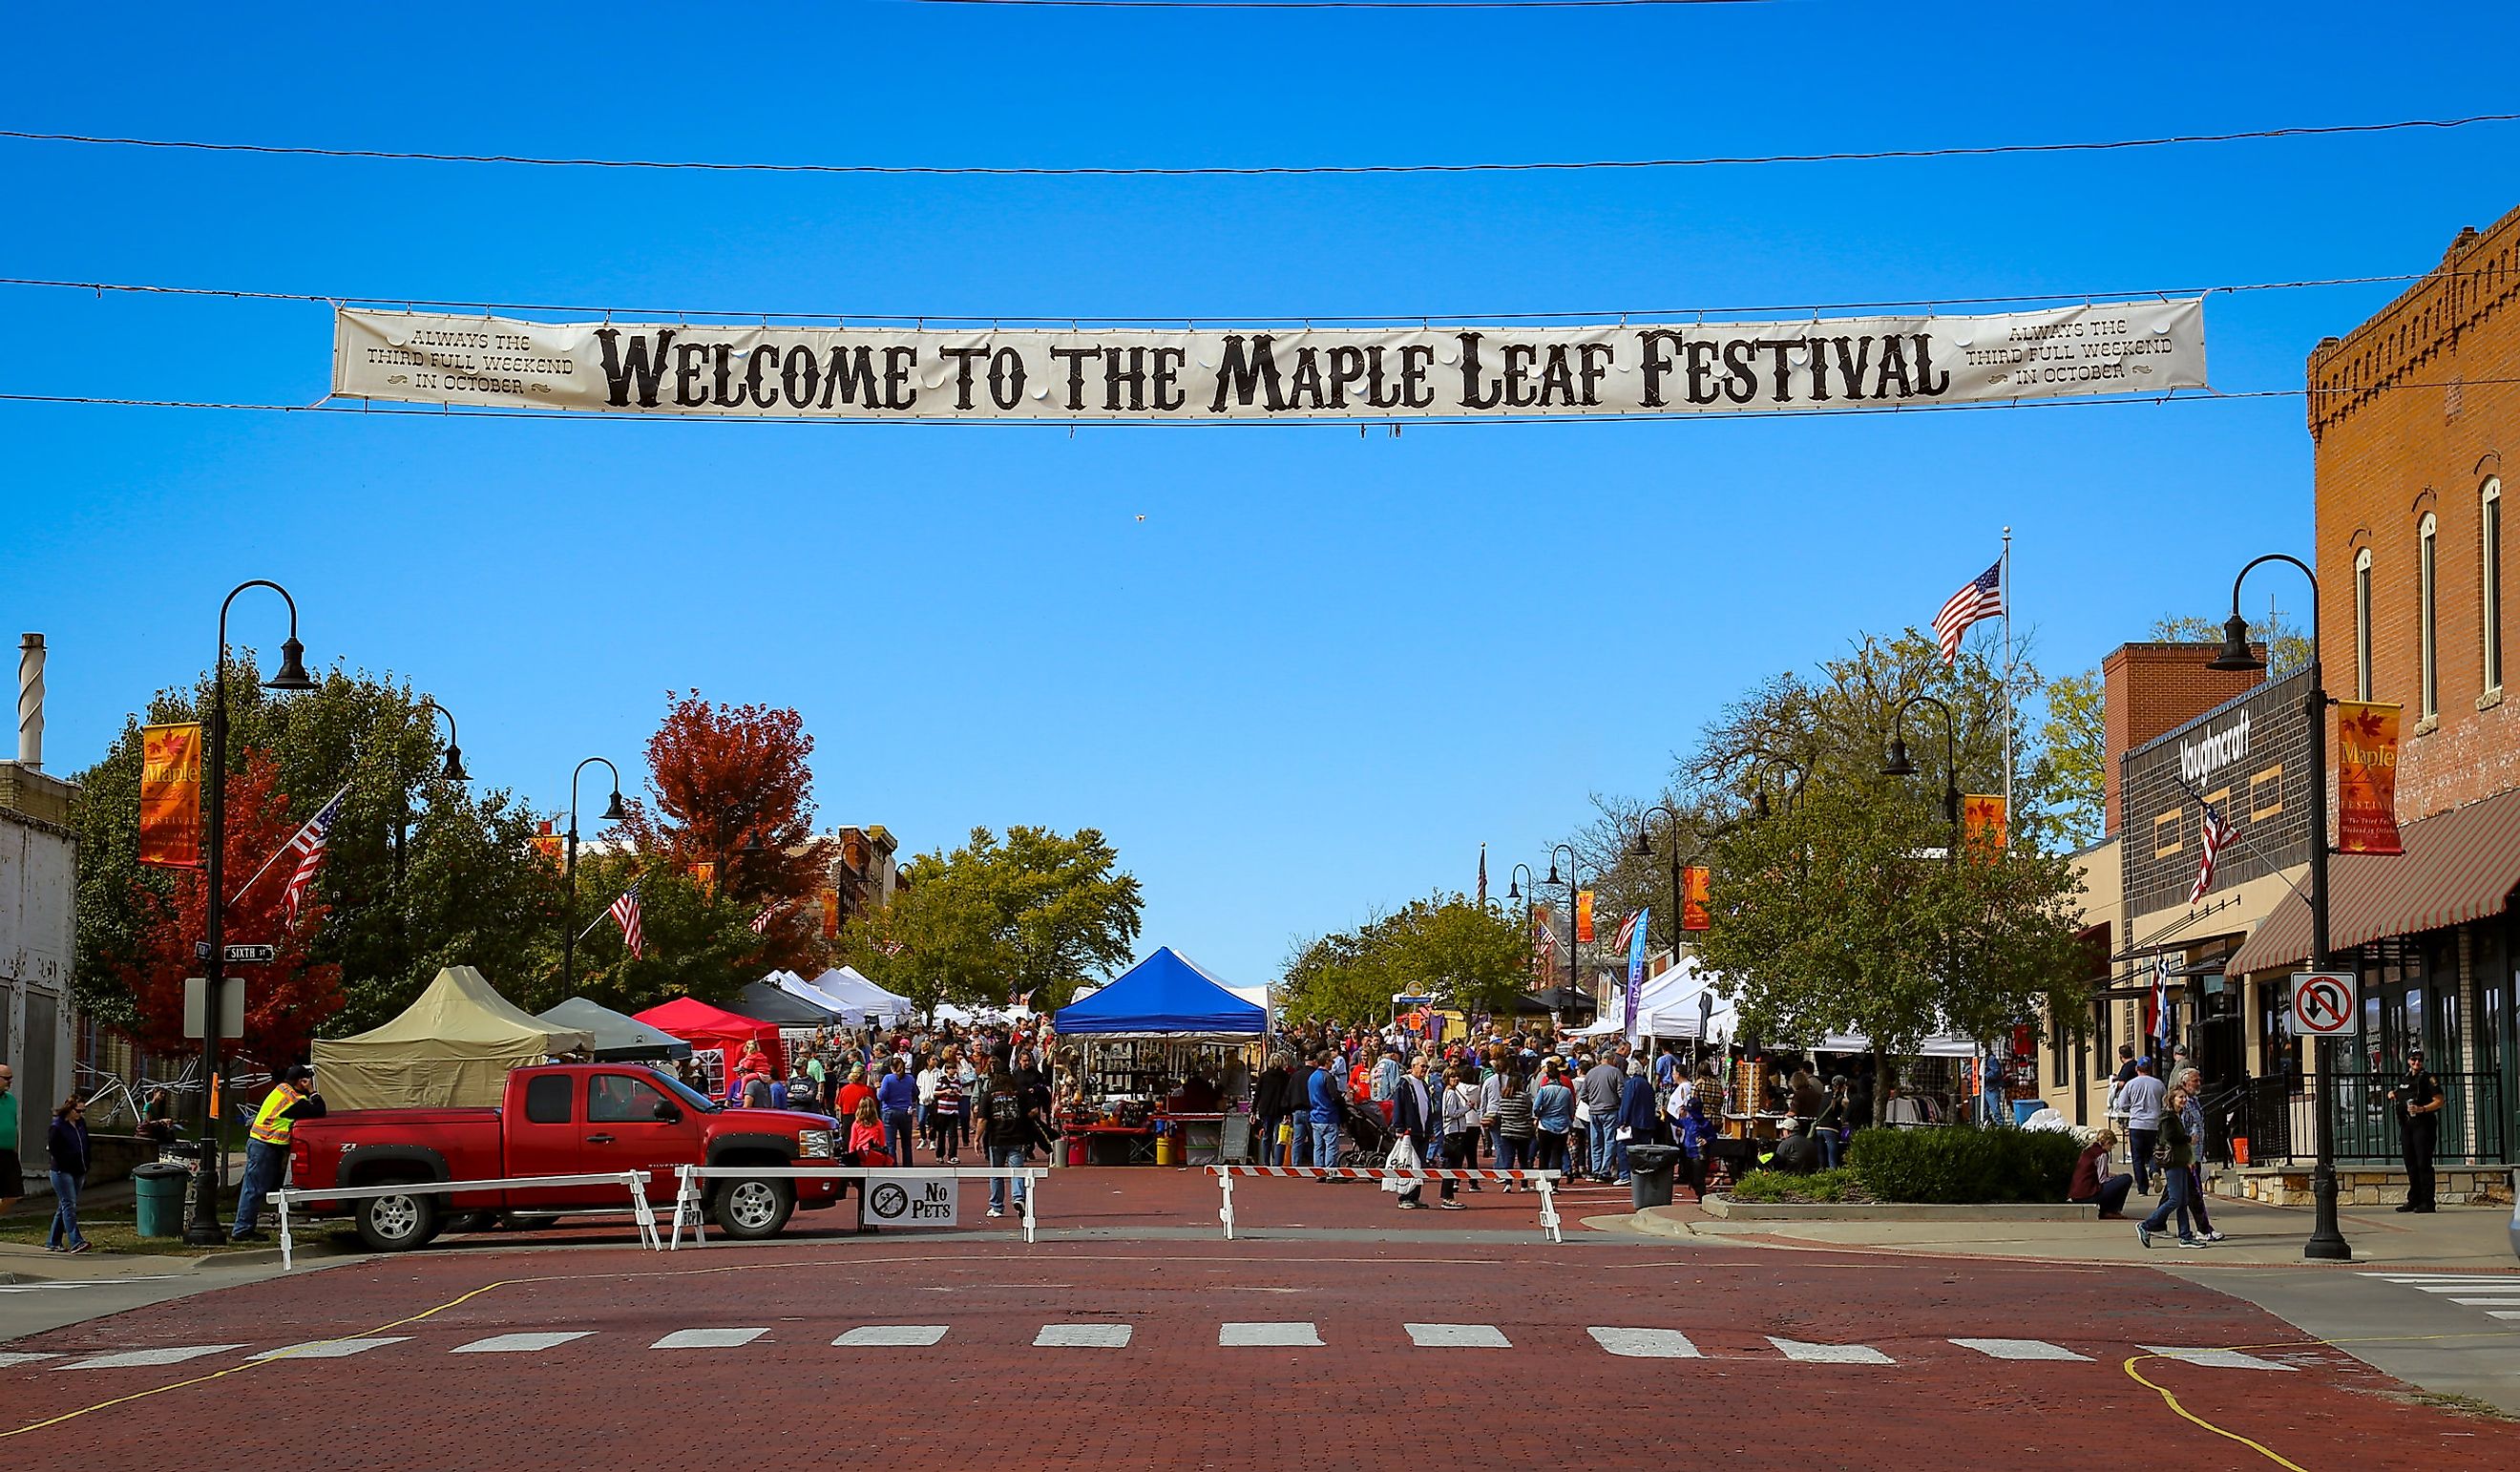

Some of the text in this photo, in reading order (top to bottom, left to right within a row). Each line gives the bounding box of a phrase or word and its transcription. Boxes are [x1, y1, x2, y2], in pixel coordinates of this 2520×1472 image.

[410, 329, 531, 351] ALWAYS THE
[2008, 319, 2128, 342] ALWAYS THE
[367, 348, 574, 375] THIRD FULL WEEKEND
[1965, 338, 2173, 367] THIRD FULL WEEKEND
[592, 327, 1951, 413] WELCOME TO THE MAPLE LEAF FESTIVAL
[2016, 363, 2126, 386] IN OCTOBER
[415, 373, 524, 394] IN OCTOBER
[2179, 707, 2251, 788] Vaughncraft
[2340, 741, 2396, 770] Maple
[143, 761, 198, 788] Maple
[142, 816, 198, 825] FESTIVAL
[231, 947, 255, 958] SIXTH
[911, 1199, 951, 1219] PETS
